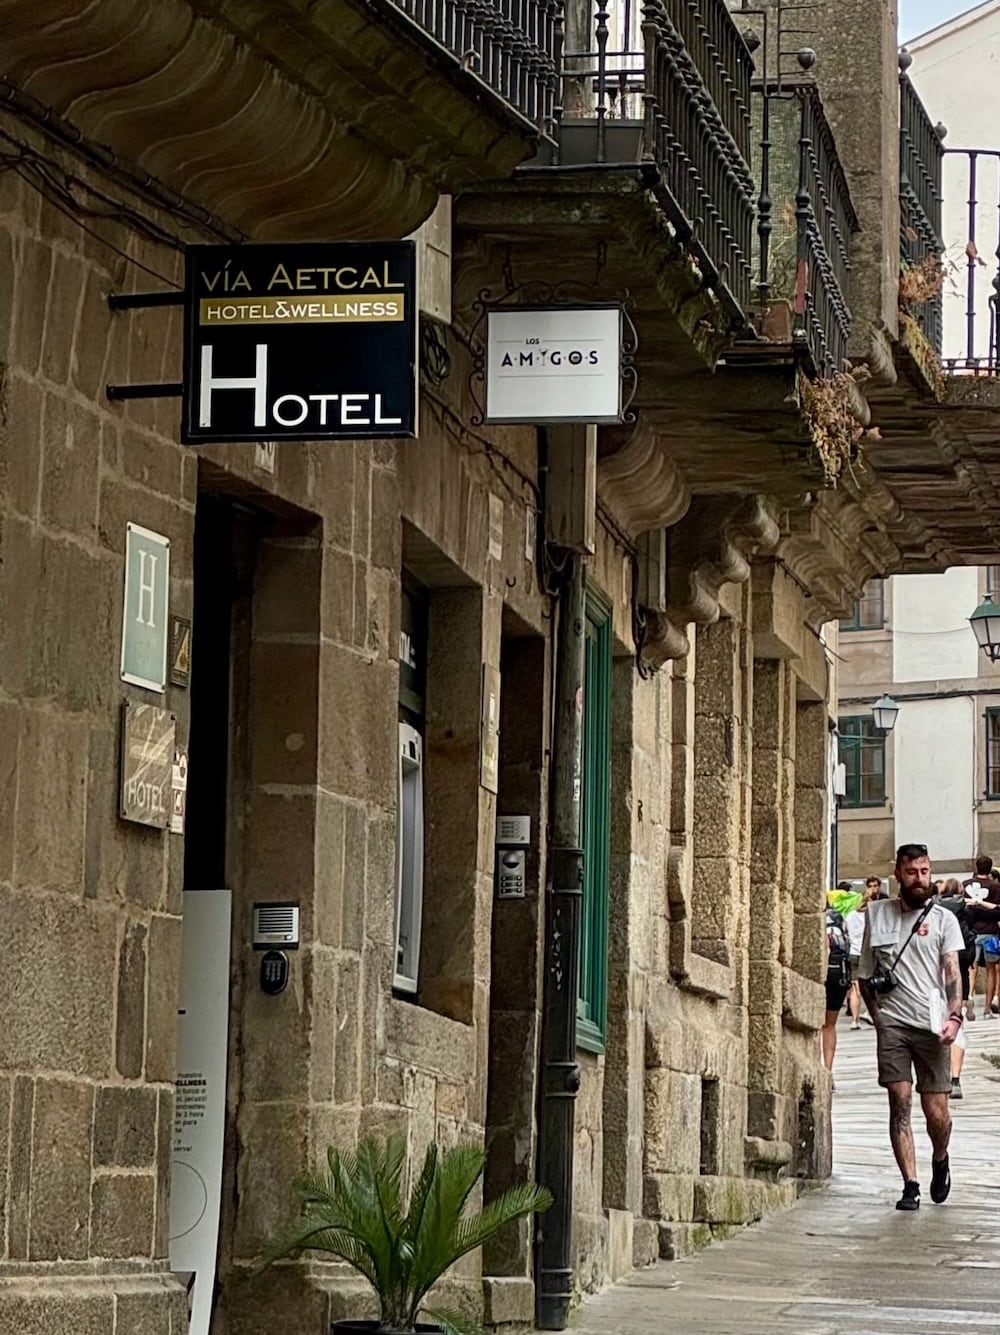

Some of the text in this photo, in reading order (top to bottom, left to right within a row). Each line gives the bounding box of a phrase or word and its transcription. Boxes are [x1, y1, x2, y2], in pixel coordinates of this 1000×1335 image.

[267, 260, 405, 290] AETCAL
[207, 301, 398, 320] HOTEL&WELLNESS
[199, 344, 402, 427] HOTEL
[136, 550, 158, 628] H
[128, 778, 166, 813] HOTEL
